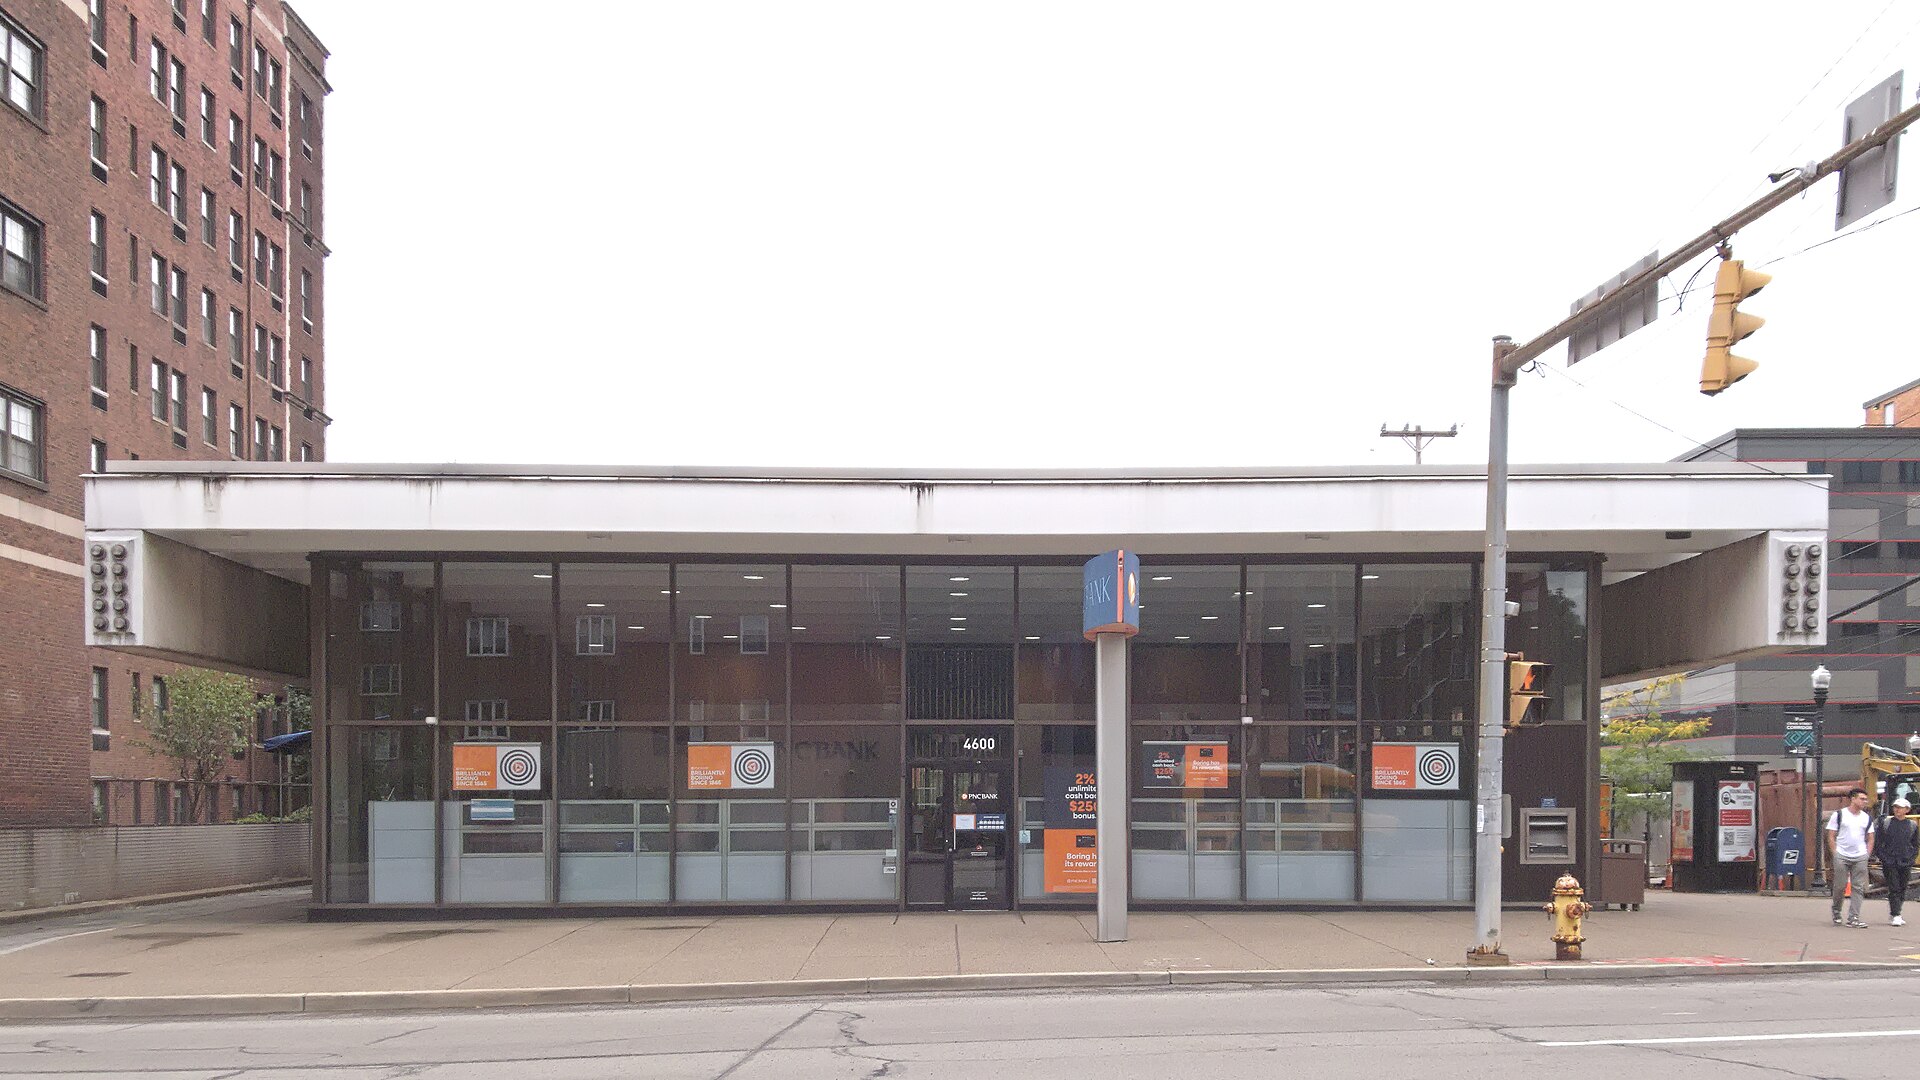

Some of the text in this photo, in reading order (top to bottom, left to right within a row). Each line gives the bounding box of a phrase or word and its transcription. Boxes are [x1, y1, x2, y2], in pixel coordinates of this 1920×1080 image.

[1084, 575, 1111, 606] ANK
[963, 738, 995, 750] 4600
[1076, 773, 1095, 784] 2%
